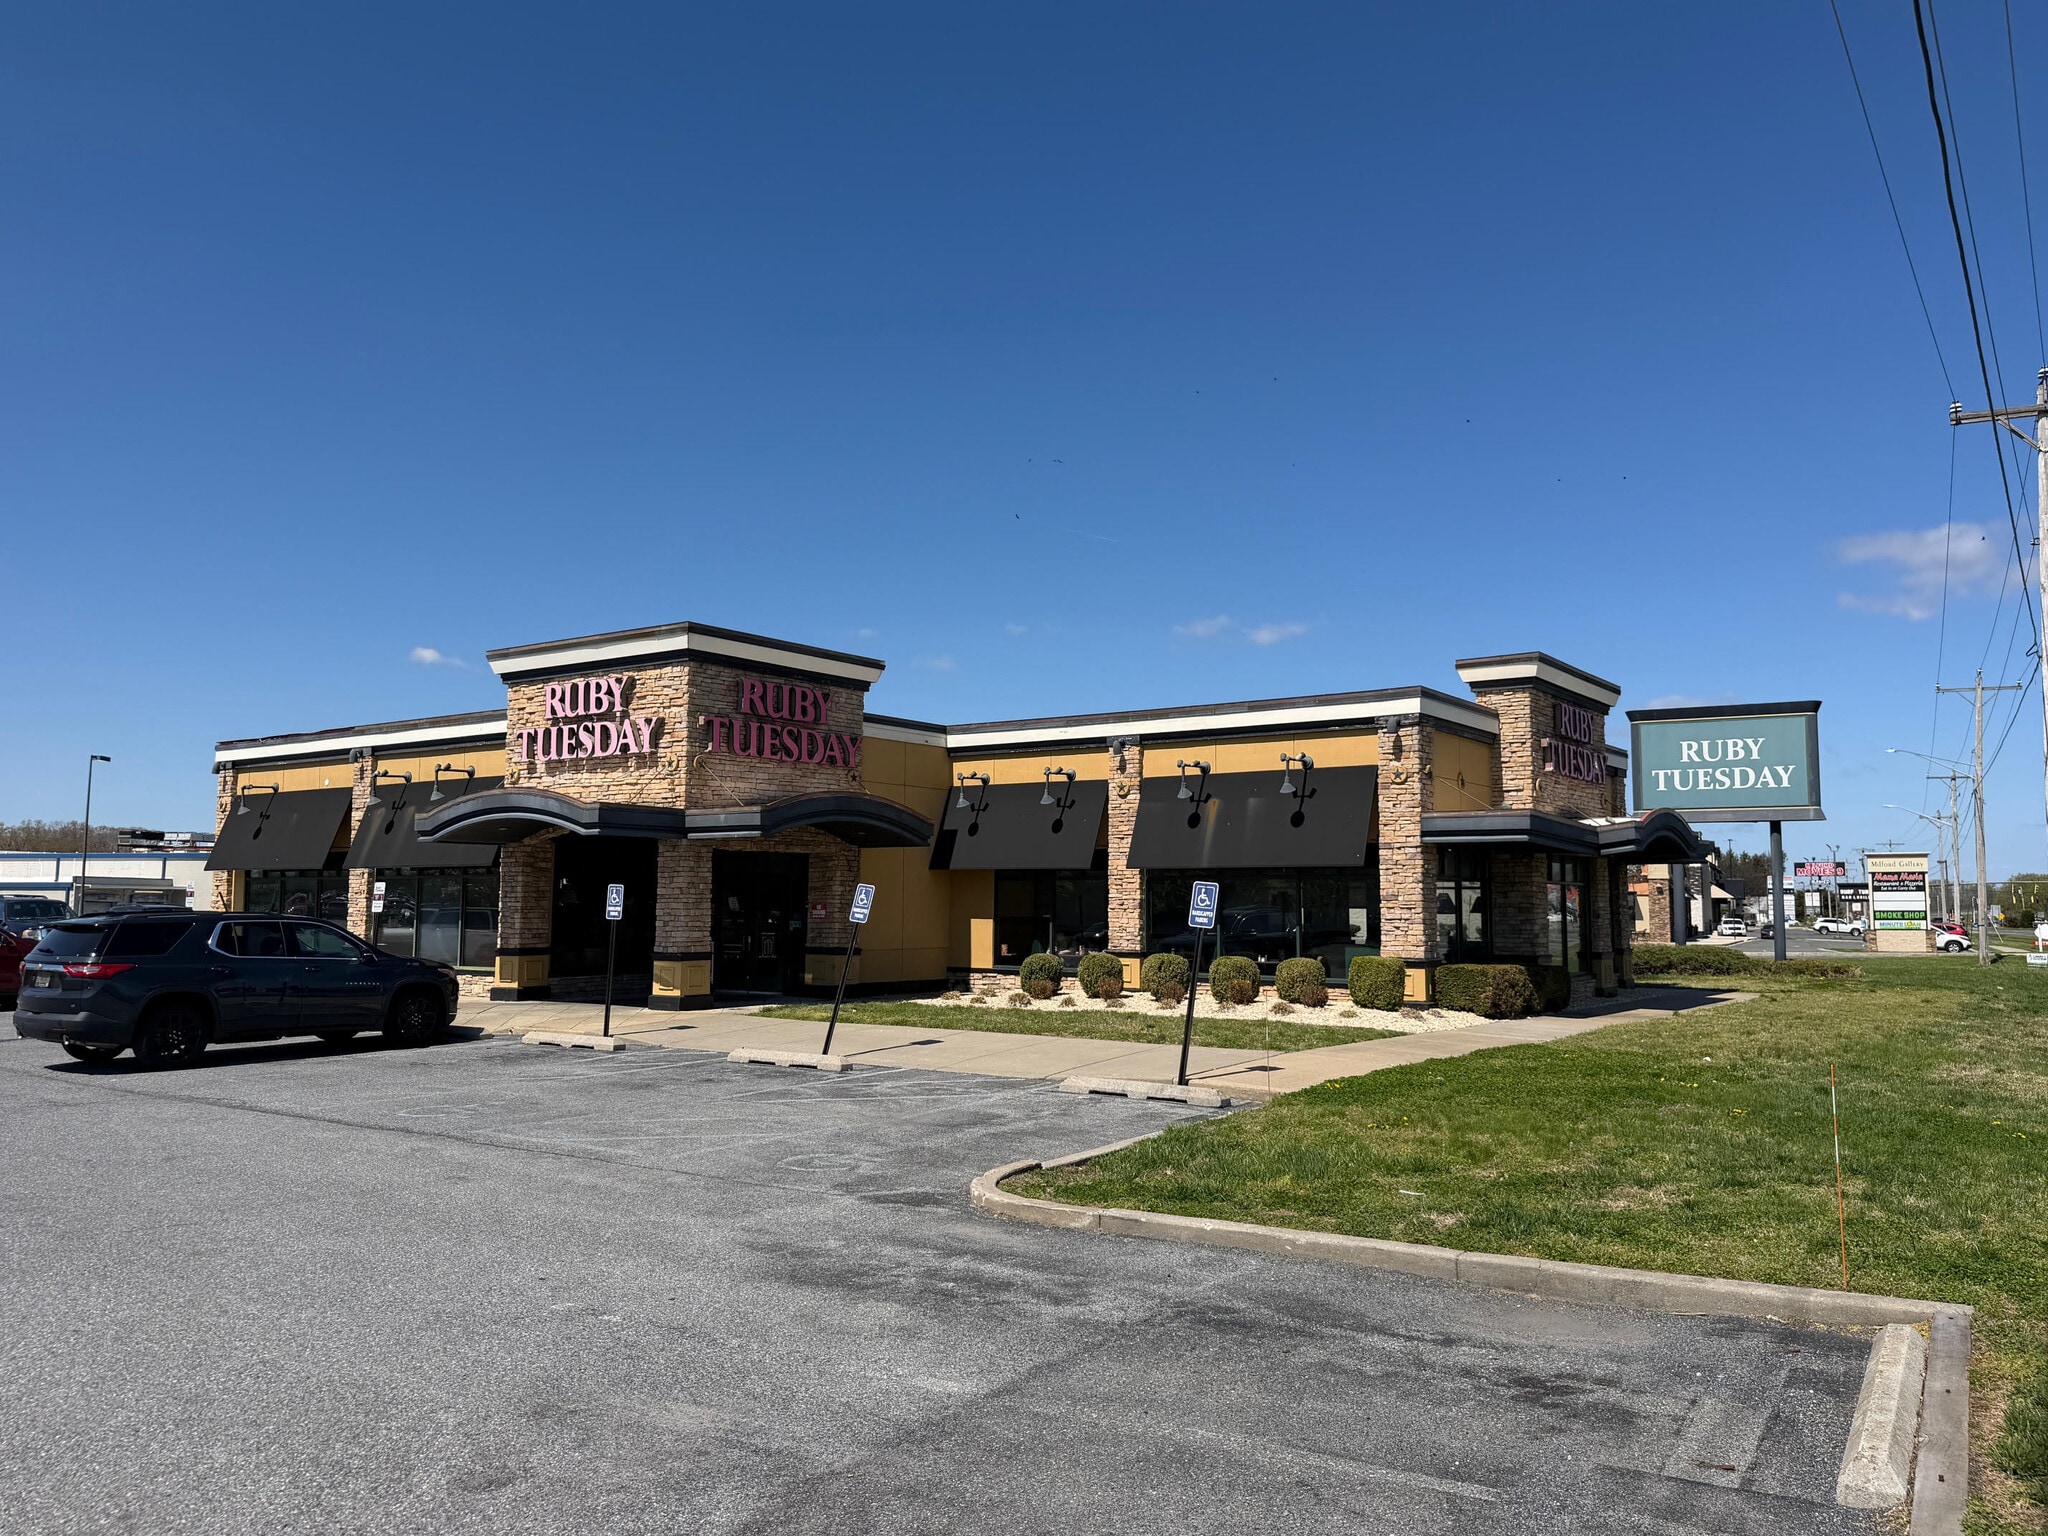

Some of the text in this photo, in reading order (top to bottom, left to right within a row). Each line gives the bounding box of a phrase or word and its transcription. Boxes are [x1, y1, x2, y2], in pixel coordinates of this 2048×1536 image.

[544, 676, 628, 720] RUBY
[740, 678, 834, 724] RUBY
[517, 716, 657, 762] TUESDAY
[704, 715, 863, 768] TUESDAY
[1560, 702, 1594, 745] RUBY
[1549, 738, 1608, 785] TUESDAY
[1679, 737, 1766, 763] RUBY
[1651, 765, 1796, 792] TUESDAY
[1796, 866, 1844, 876] MOVIES 9
[1875, 911, 1925, 919] SMOKE SHOP
